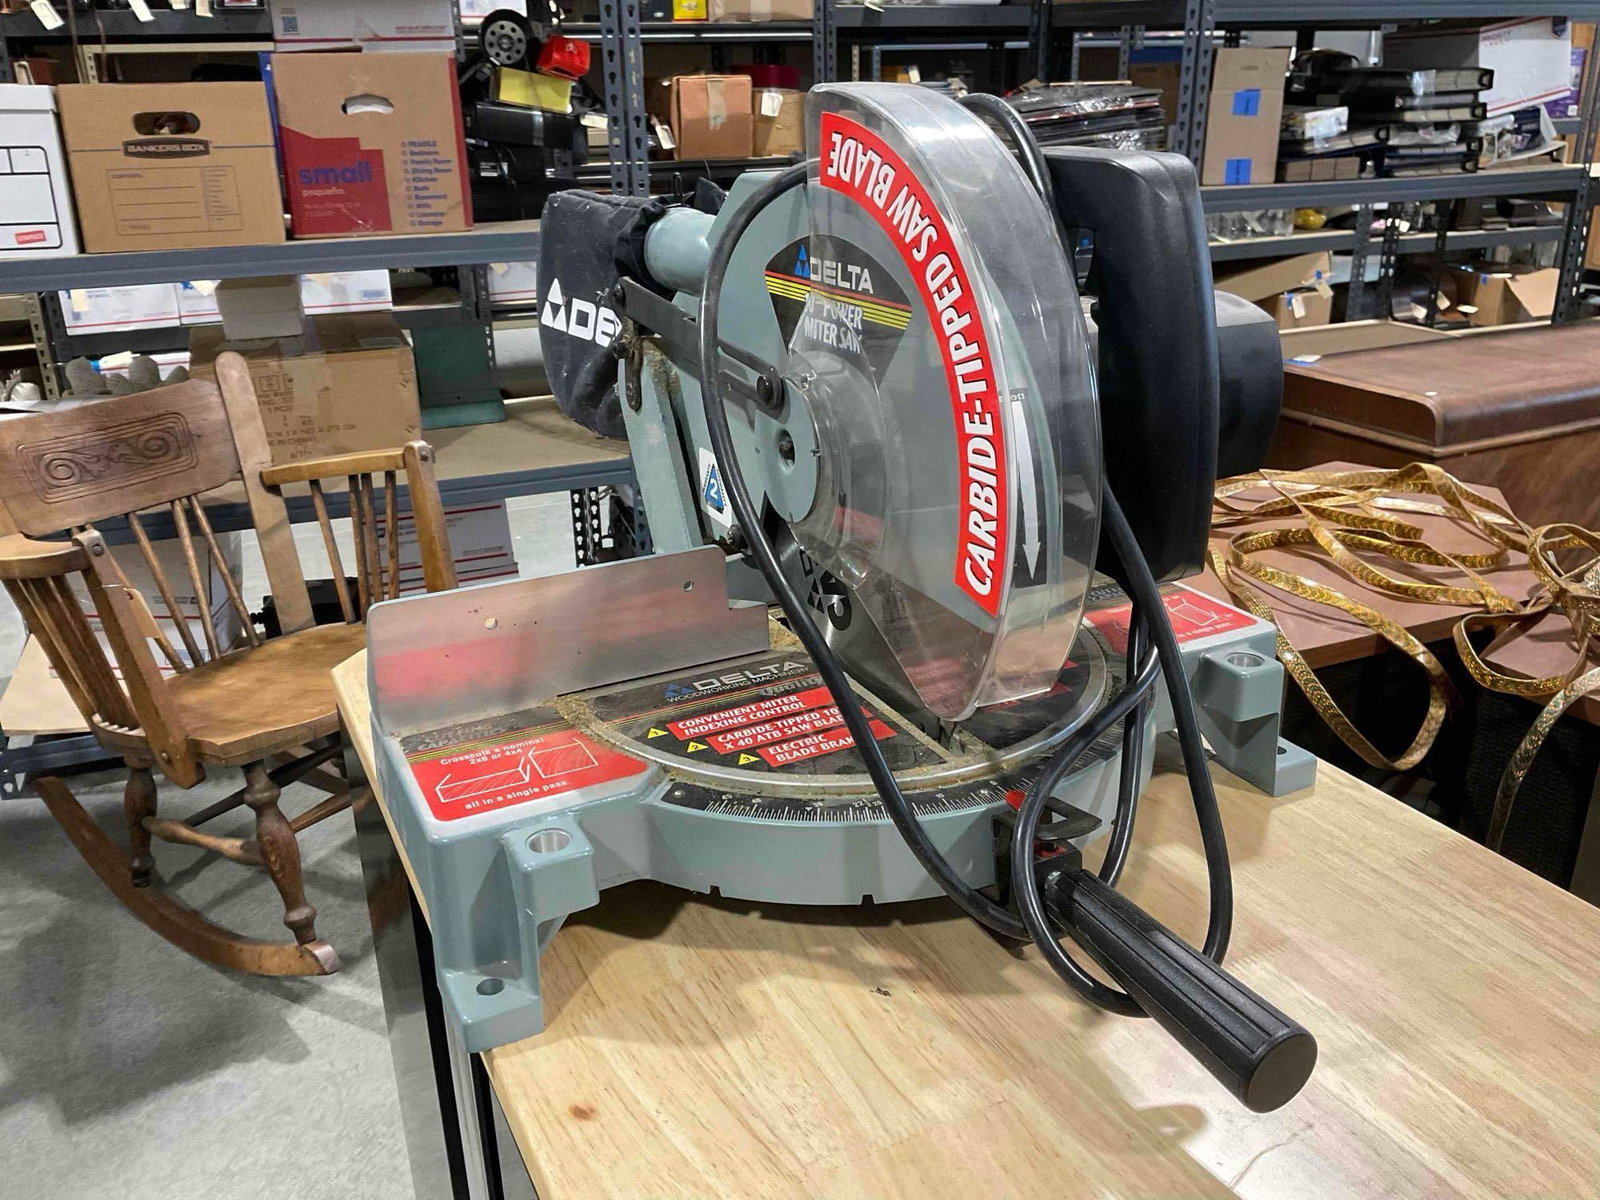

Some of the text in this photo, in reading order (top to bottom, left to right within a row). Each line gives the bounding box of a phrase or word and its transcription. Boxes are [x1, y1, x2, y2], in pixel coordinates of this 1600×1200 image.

[127, 143, 206, 153] BANKERS BOX
[299, 160, 372, 185] small
[827, 131, 896, 210] BLADE
[886, 184, 939, 262] SAW
[810, 256, 874, 295] DELTA
[823, 301, 864, 330] POWER
[804, 316, 838, 347] MITER
[925, 252, 999, 597] CARBIDE-TIPPED
[667, 666, 810, 703] WOODWORKING MACHINERY
[693, 661, 806, 691] DELTA
[678, 695, 800, 729] CONVENIENT MITER
[683, 702, 807, 737] INDEXING CONTROL
[717, 711, 820, 743] CARBIDE-TIPPED
[502, 737, 545, 751] nominal
[723, 714, 844, 750] X 40 ATB SAW BLAD
[768, 734, 828, 755] ELECTRIC
[468, 755, 489, 765] 2x6
[504, 748, 523, 756] 4x4
[775, 736, 855, 762] BLADE BRAK
[464, 800, 480, 810] all
[482, 797, 494, 805] in
[505, 786, 540, 800] single
